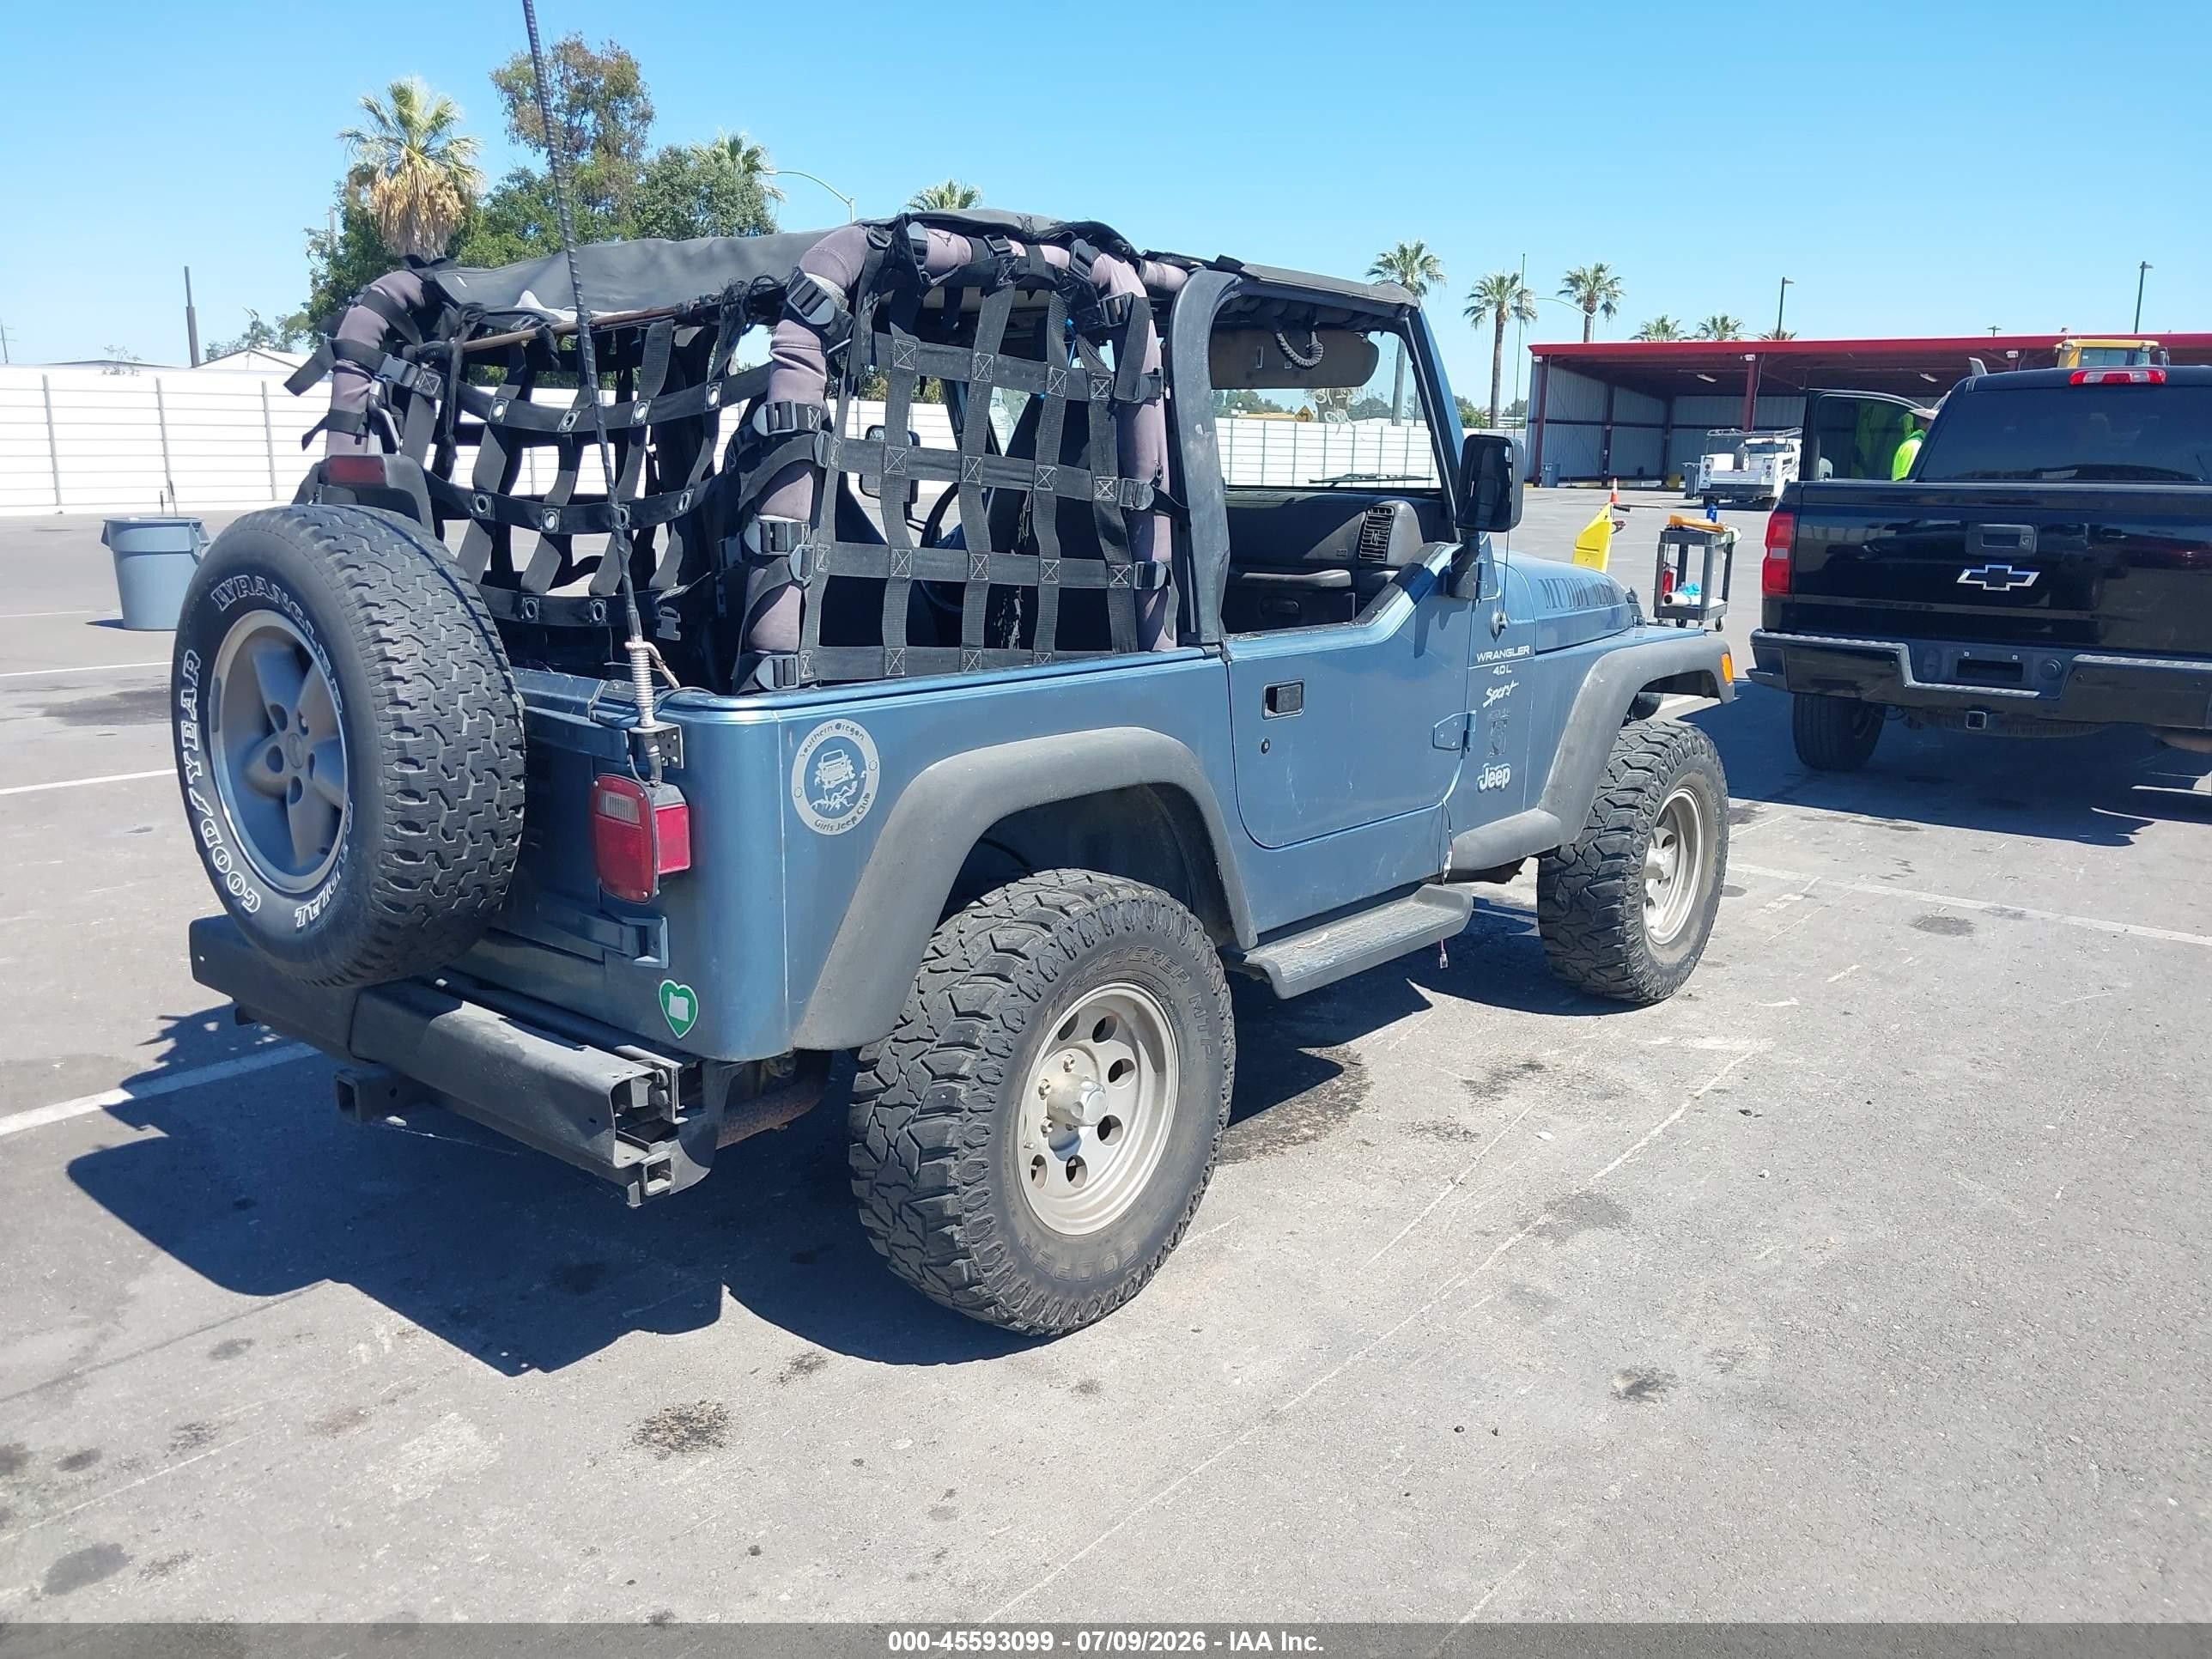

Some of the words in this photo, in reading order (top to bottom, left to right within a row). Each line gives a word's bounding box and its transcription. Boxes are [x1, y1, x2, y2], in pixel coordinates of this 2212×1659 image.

[1476, 645, 1530, 662] WRANGLER
[1482, 679, 1519, 708] Sport
[800, 726, 833, 757] Southern
[835, 722, 865, 740] Oregon
[180, 649, 261, 913] GOODYEAR
[1478, 764, 1512, 791] Jeep
[815, 819, 834, 831] Girls
[836, 816, 858, 831] Jeep
[856, 792, 871, 815] Club
